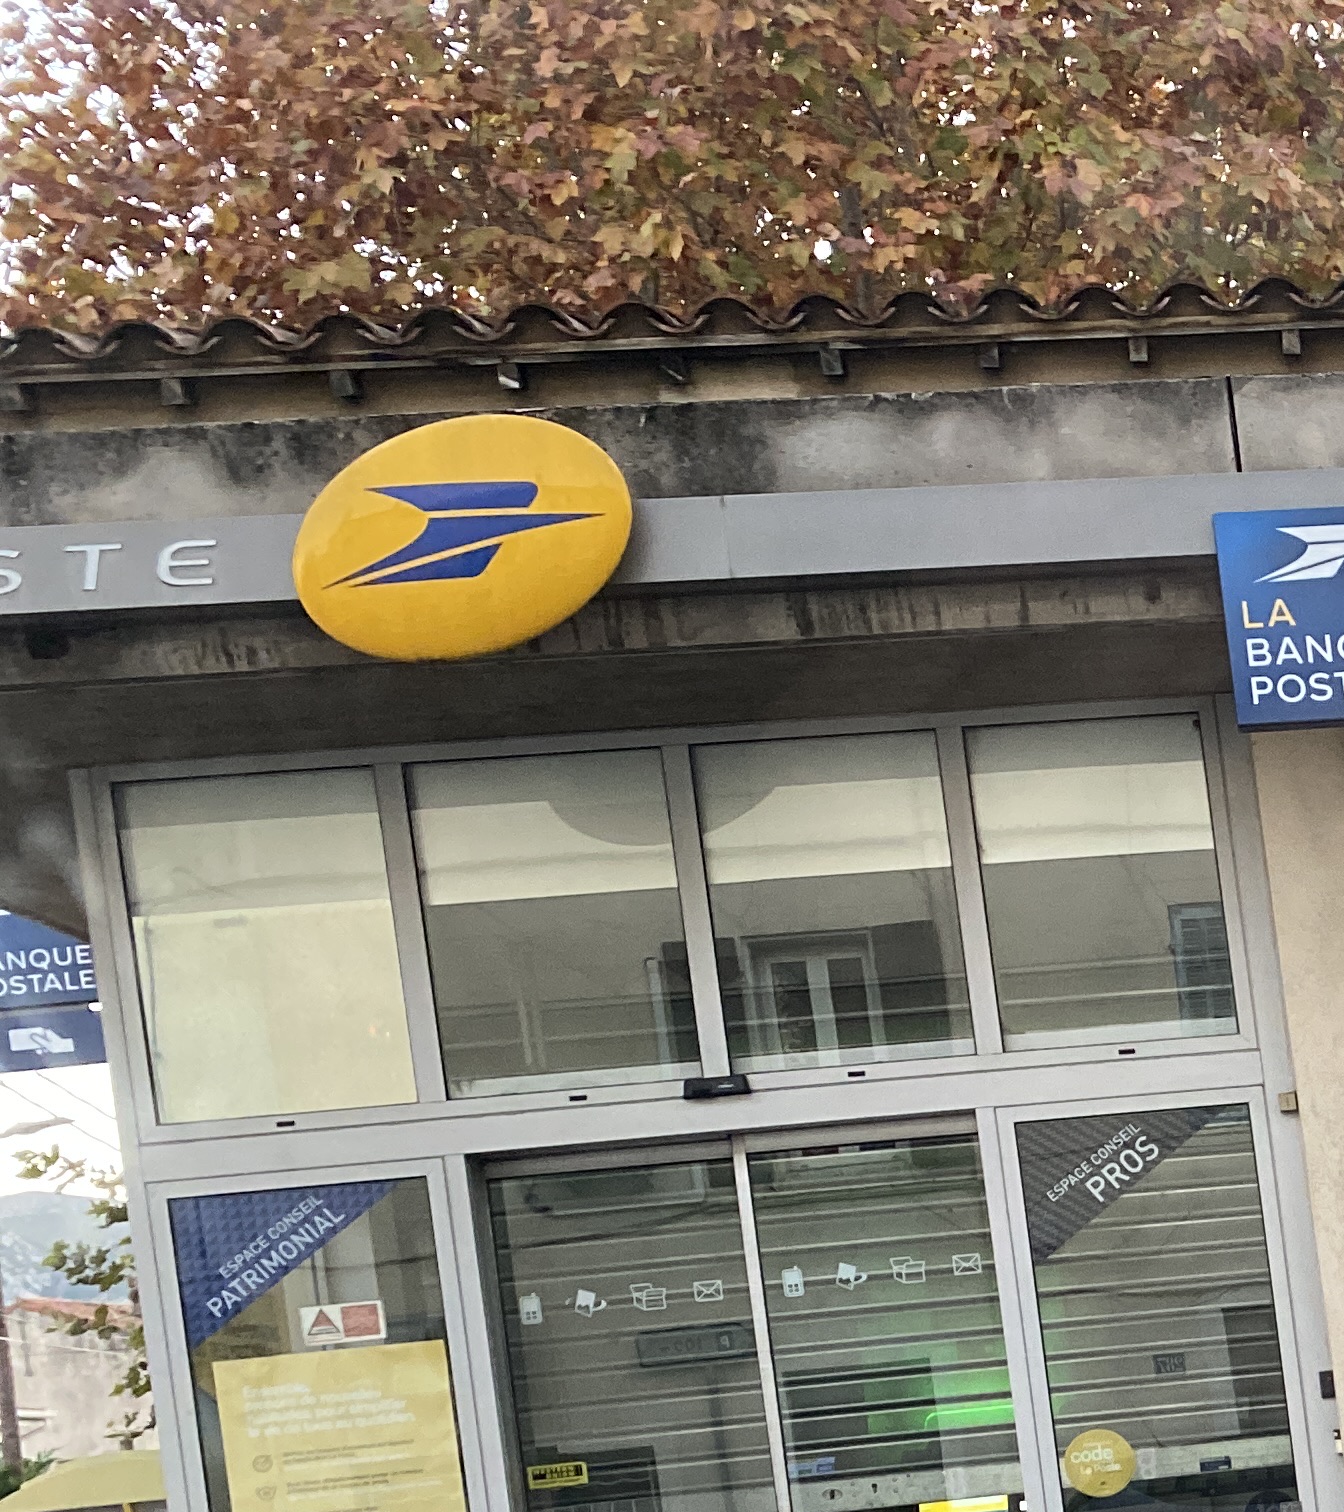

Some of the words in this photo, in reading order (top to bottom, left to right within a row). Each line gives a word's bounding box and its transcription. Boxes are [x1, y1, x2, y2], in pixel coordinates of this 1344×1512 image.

[1241, 598, 1296, 629] LA
[0, 944, 92, 971] NQUE
[1046, 1161, 1094, 1202] ESPACE
[1090, 1123, 1141, 1165] CONSEIL
[1084, 1135, 1159, 1203] PROS
[206, 1208, 347, 1318] PATRIMONIAL
[219, 1235, 270, 1279] ESPACE
[267, 1195, 324, 1240] CONSEIL
[1070, 1444, 1114, 1463] code
